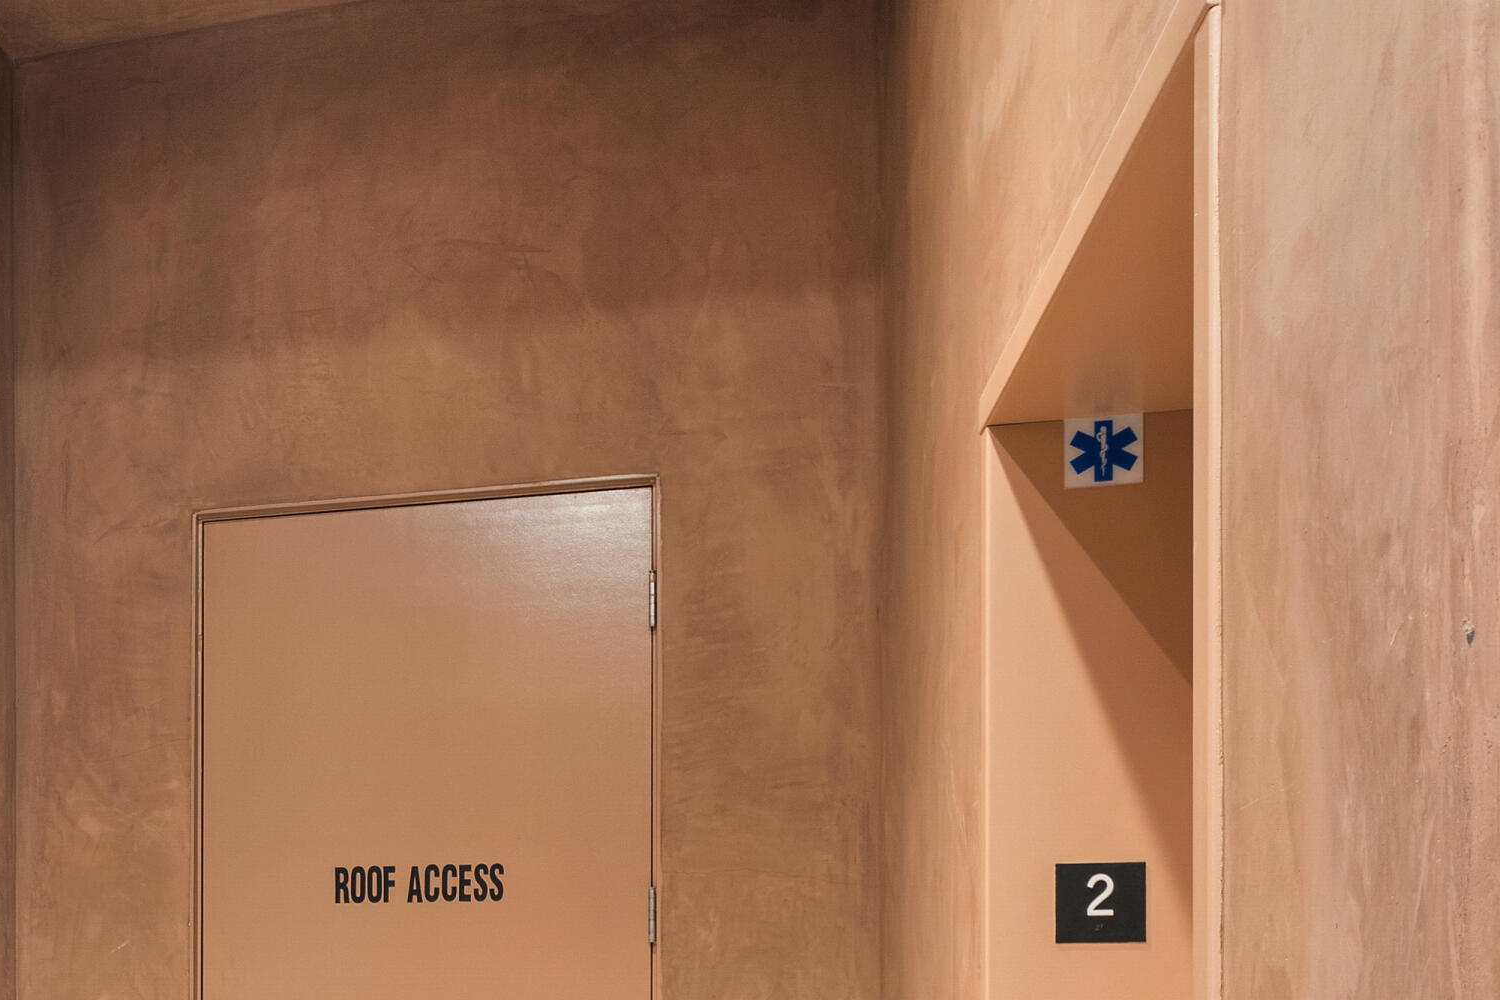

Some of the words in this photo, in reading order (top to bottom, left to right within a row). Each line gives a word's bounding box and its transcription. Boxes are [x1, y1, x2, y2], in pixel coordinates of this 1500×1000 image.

[334, 864, 396, 904] ROOF
[407, 862, 505, 903] ACCESS
[1086, 872, 1115, 917] 2
